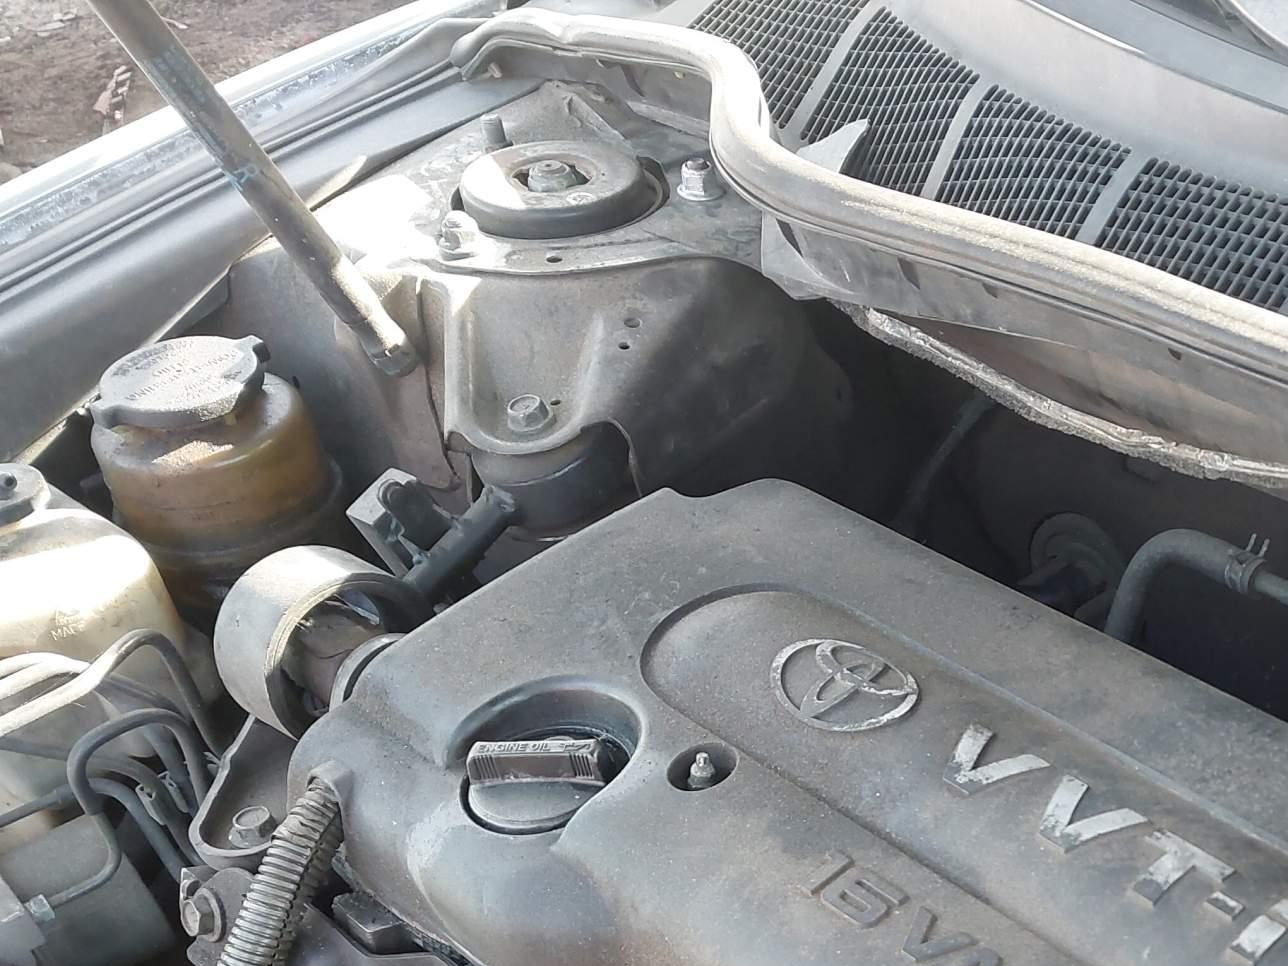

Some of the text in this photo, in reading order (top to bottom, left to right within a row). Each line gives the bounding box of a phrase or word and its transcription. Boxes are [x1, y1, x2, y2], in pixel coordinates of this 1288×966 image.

[478, 742, 552, 754] ENGINE OIL
[797, 848, 911, 930] 16
